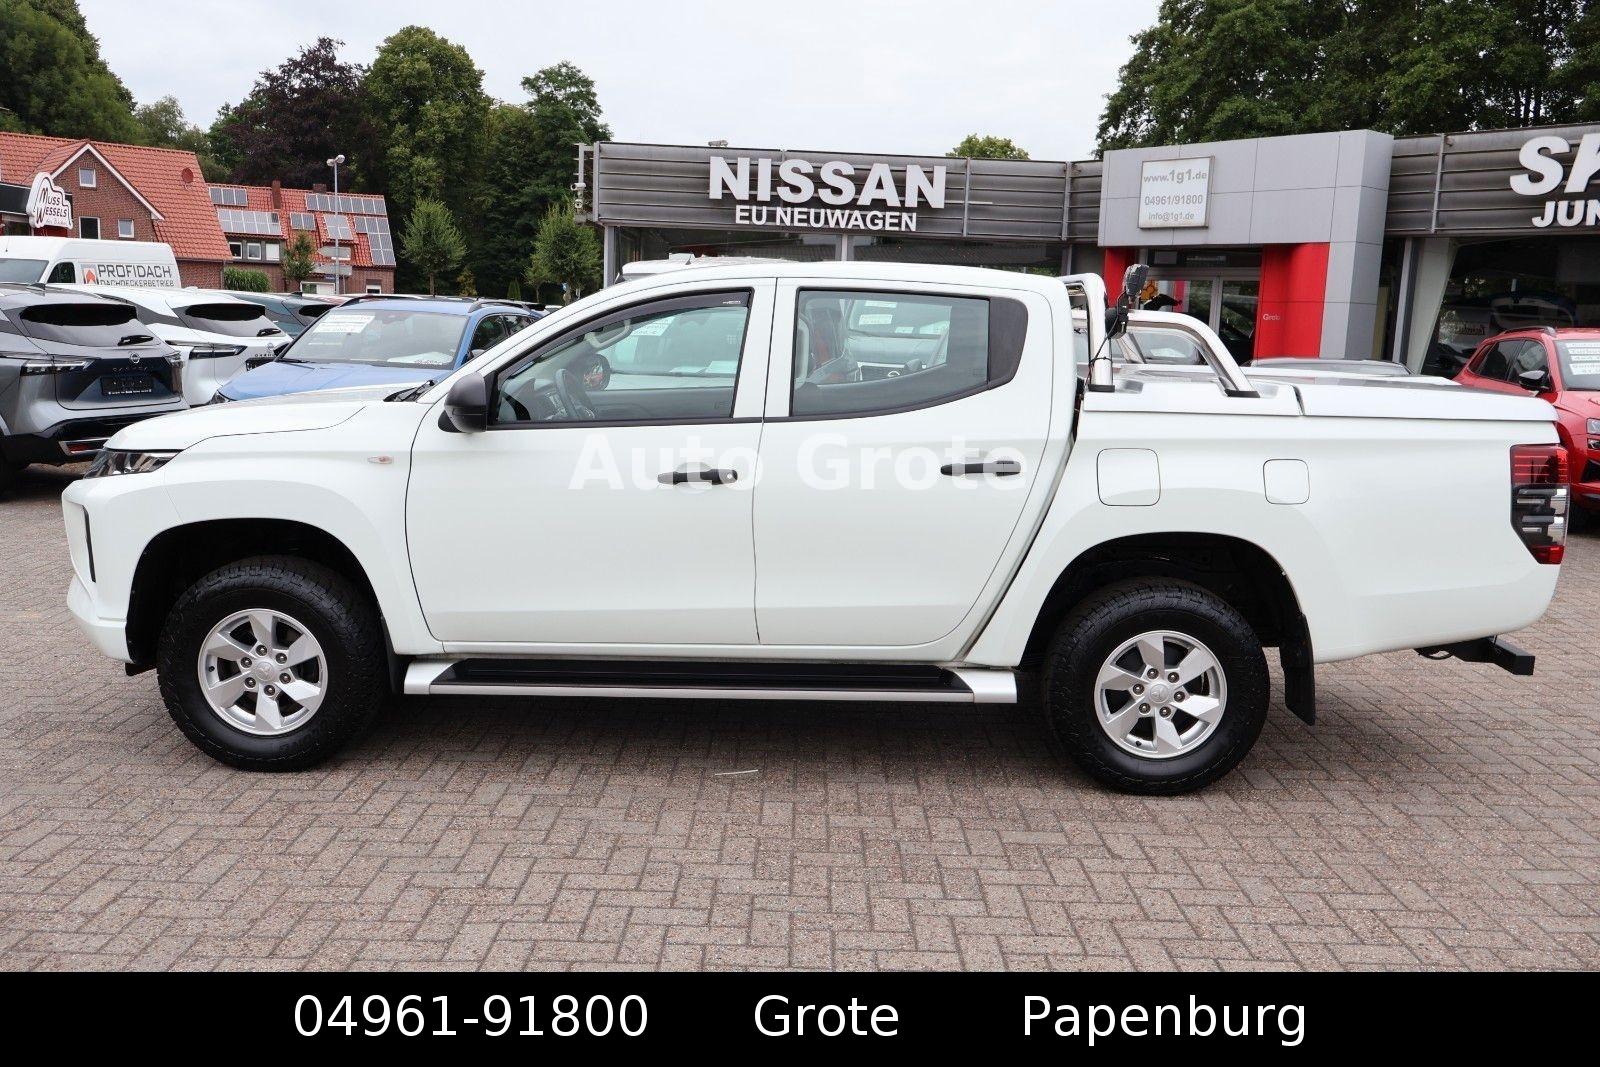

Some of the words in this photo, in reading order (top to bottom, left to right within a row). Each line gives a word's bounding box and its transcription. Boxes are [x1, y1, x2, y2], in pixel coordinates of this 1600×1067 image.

[708, 156, 947, 209] NISSAN
[1143, 169, 1208, 184] www.1g1.de
[1144, 194, 1204, 206] 04961/91800
[735, 205, 767, 226] EU
[775, 207, 917, 232] NEUWAGEN
[1149, 211, 1195, 222] info@1g1.de
[97, 264, 172, 278] PROFIDACH
